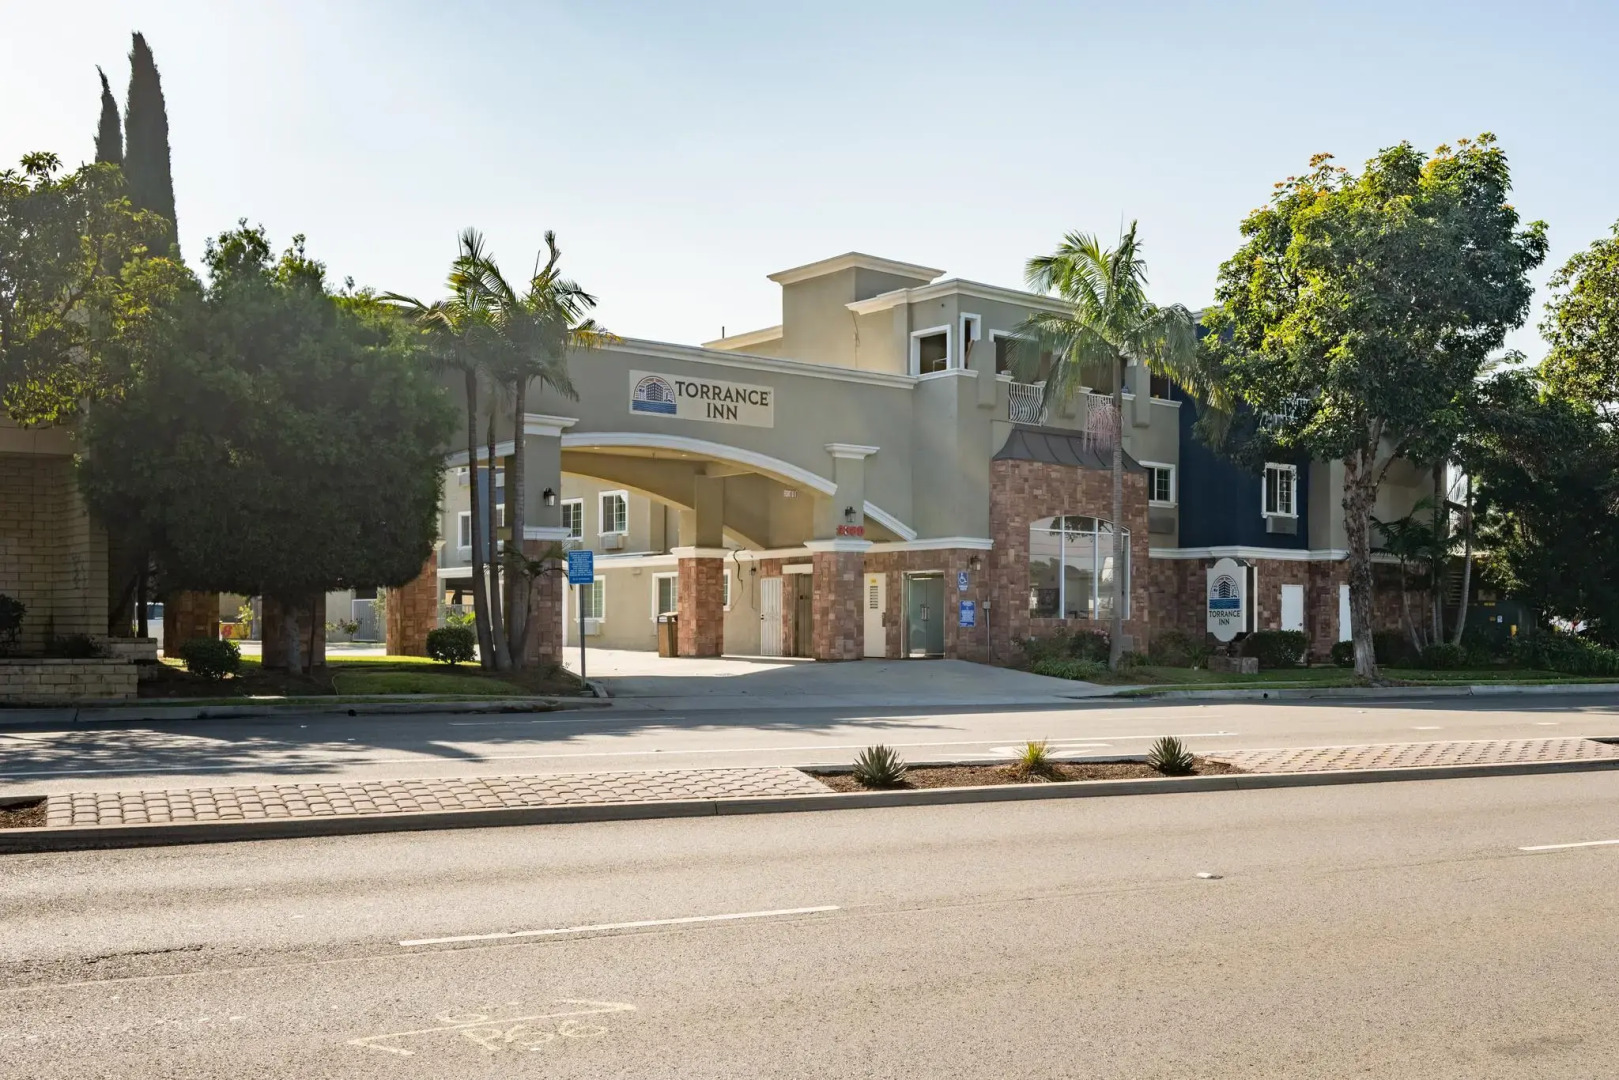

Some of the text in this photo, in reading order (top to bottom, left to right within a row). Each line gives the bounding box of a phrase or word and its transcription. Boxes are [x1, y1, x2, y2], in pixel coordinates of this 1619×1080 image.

[675, 380, 769, 406] TORRANCE
[706, 402, 738, 421] INN
[1208, 610, 1241, 618] TORRANCE
[1218, 618, 1230, 626] INN
